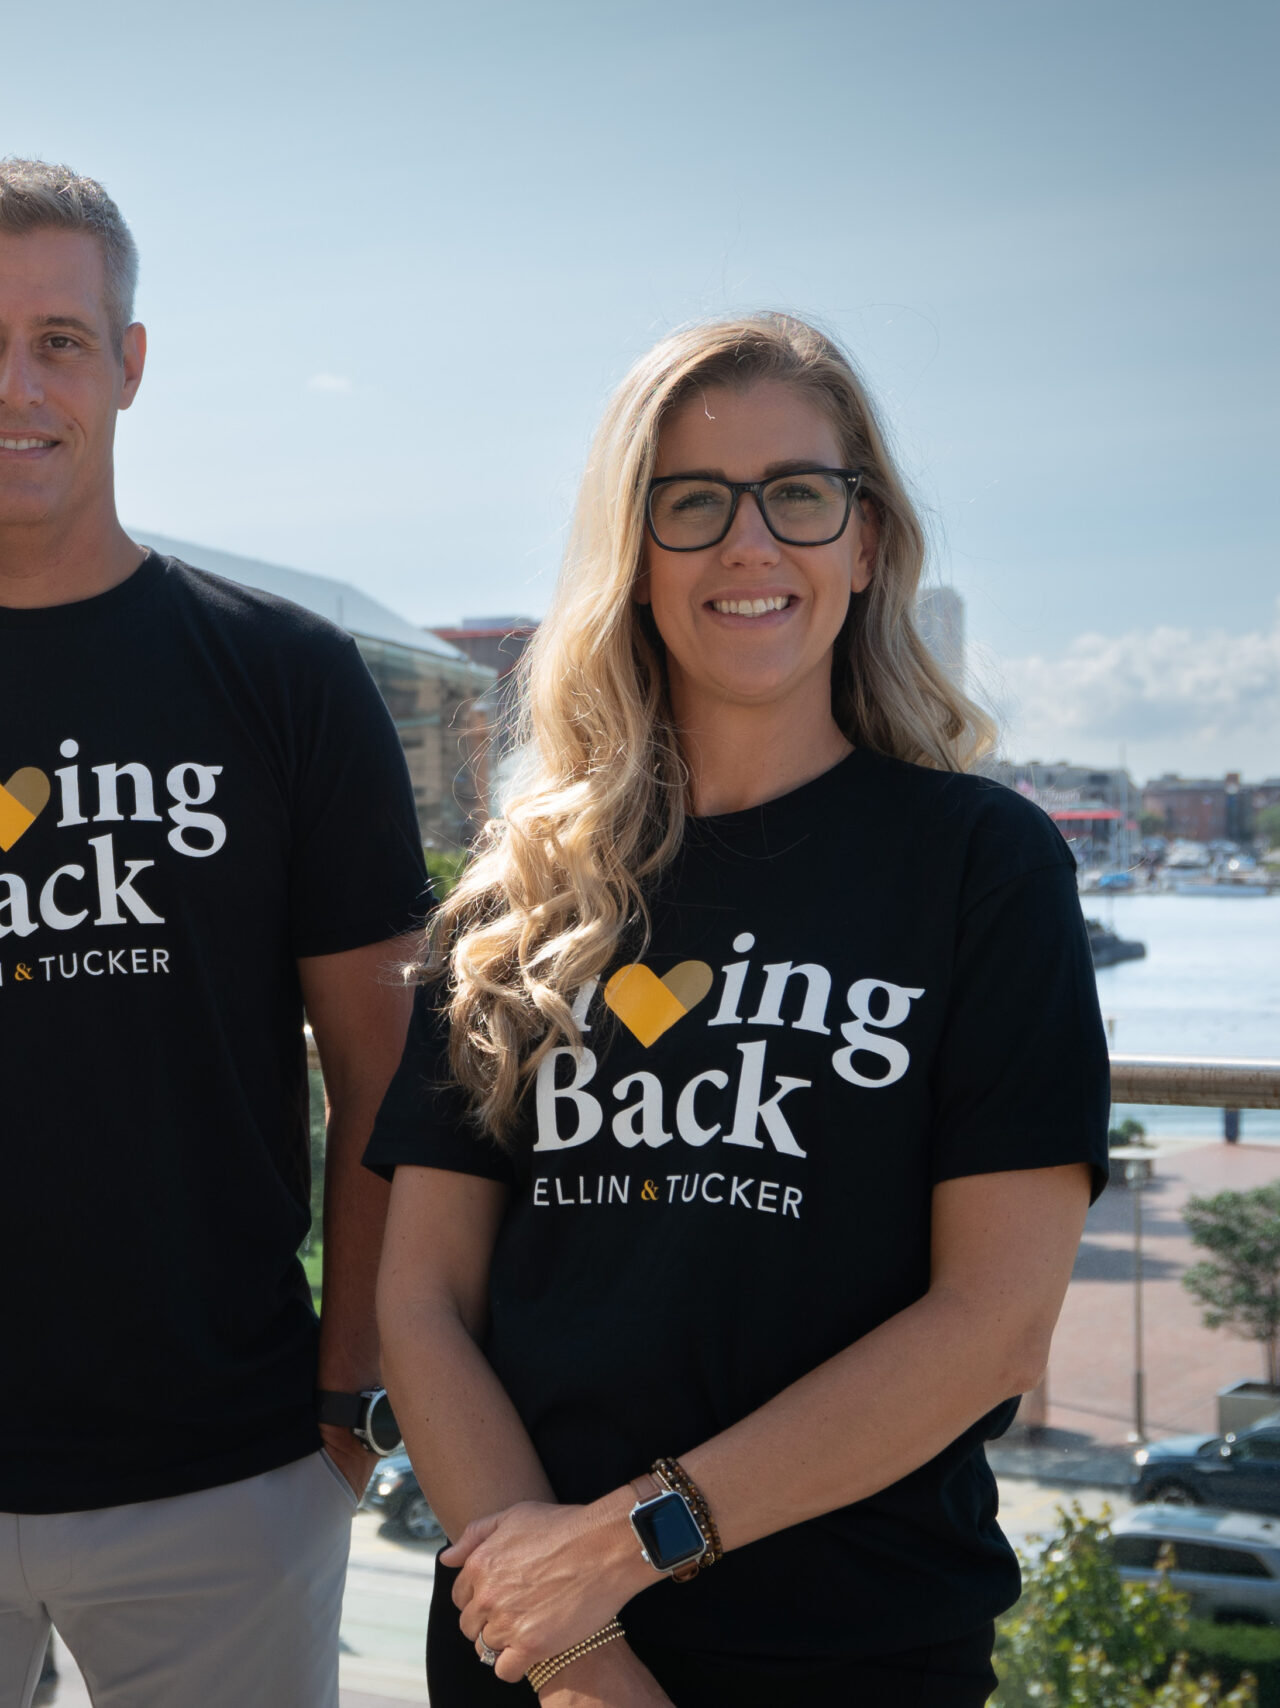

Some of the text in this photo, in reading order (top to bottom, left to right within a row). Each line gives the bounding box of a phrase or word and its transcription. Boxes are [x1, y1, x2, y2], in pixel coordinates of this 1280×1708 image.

[14, 963, 35, 981] &
[39, 949, 170, 982] TUCKER
[533, 1040, 812, 1159] Back
[533, 1172, 803, 1219] ELLIN & TUCKER
